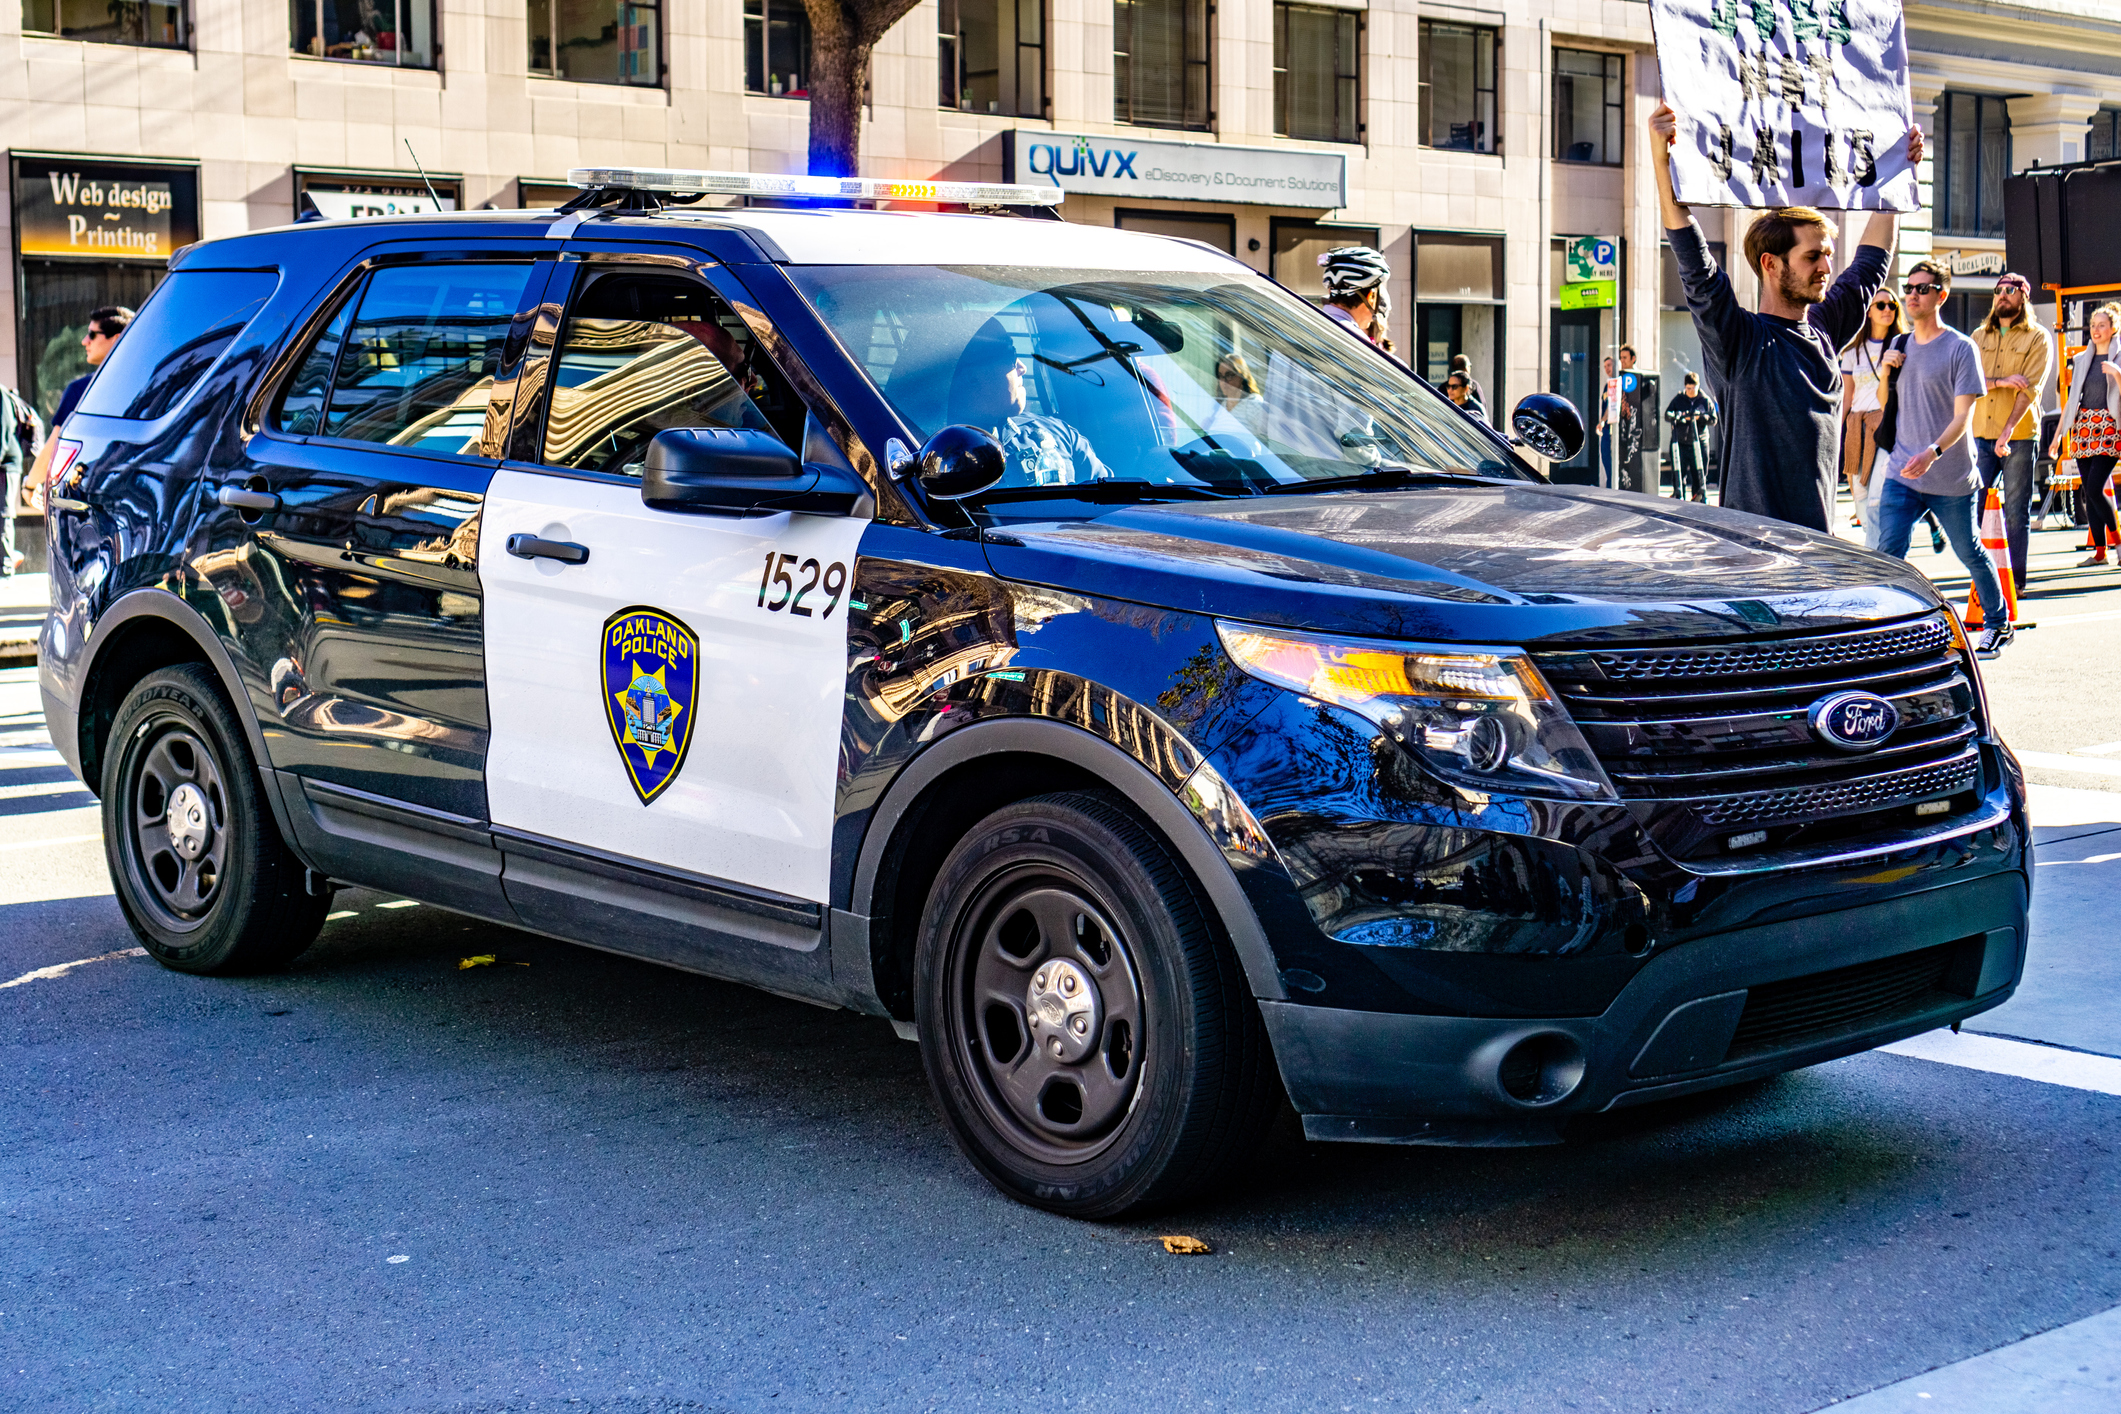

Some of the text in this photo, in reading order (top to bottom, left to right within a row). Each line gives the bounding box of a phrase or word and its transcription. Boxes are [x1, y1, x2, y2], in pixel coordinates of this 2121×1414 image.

[1738, 49, 1834, 113] NOT
[1706, 123, 1877, 188] JAILS
[49, 171, 173, 214] Web design
[1145, 168, 1338, 192] eDiscovery & Document Solutions
[67, 214, 158, 253] Printing
[1598, 245, 1610, 262] P
[1958, 256, 1998, 271] LOCAL LOVE
[1625, 376, 1632, 389] P
[757, 551, 847, 620] 1529
[612, 618, 687, 659] OAKLAND
[621, 636, 677, 670] POLICE
[1844, 703, 1886, 737] Ford
